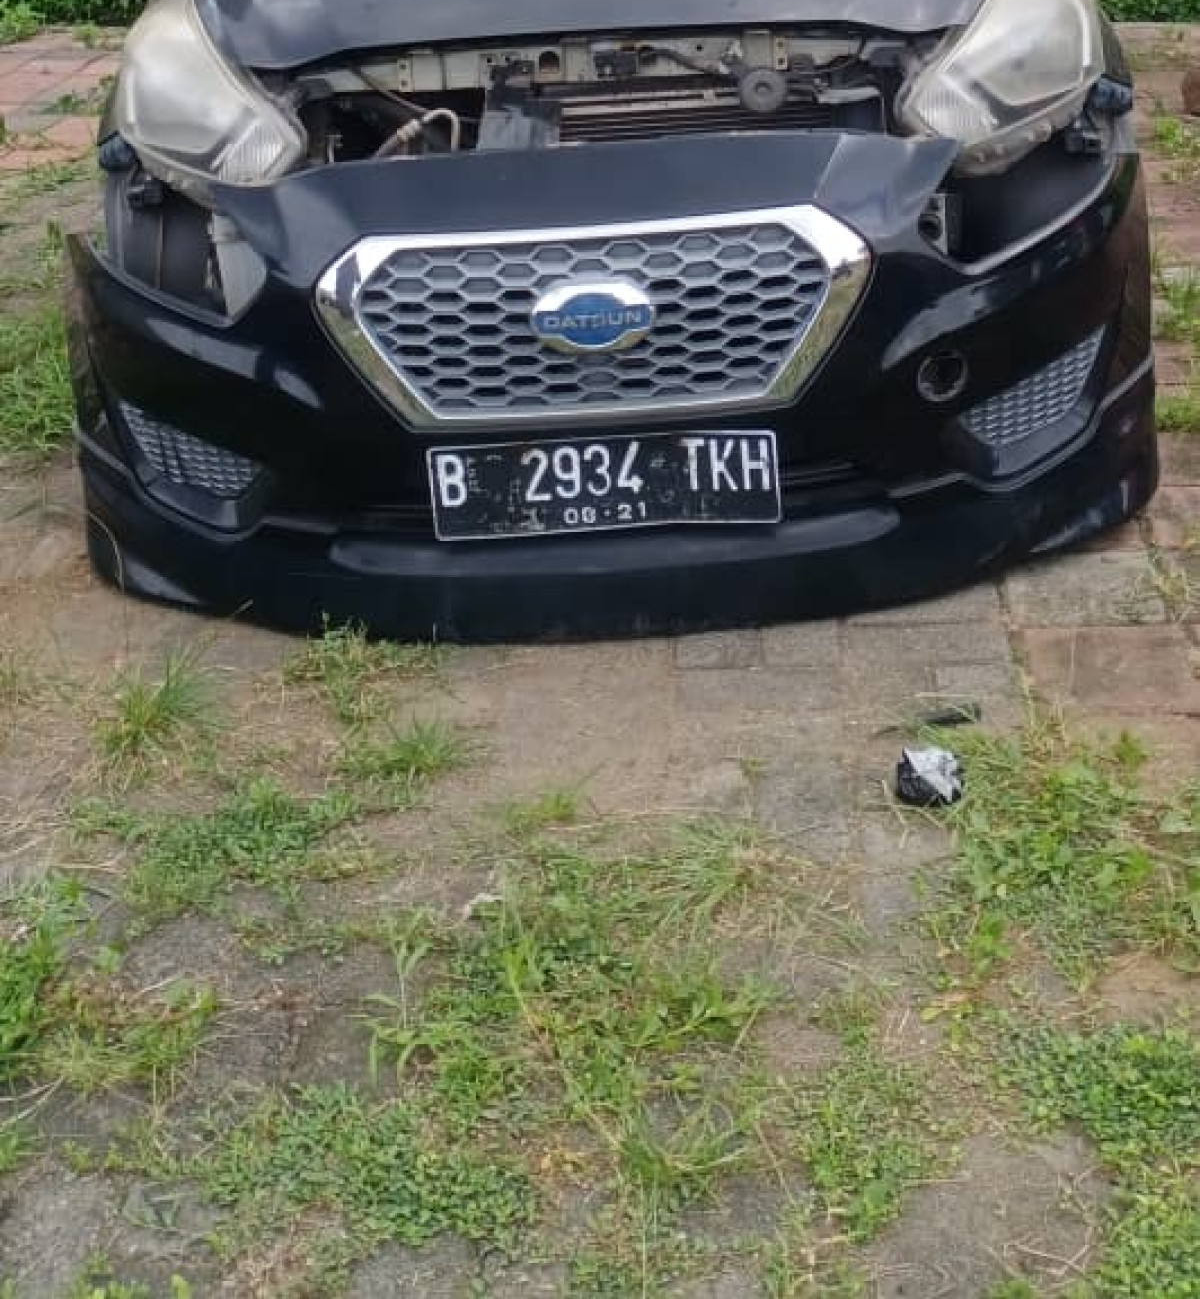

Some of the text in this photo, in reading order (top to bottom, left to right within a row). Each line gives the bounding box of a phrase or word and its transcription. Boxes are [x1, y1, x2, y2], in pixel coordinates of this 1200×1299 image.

[543, 310, 642, 329] DATSUN
[436, 454, 468, 507] B
[520, 441, 644, 502] 2934
[681, 437, 772, 492] TKH
